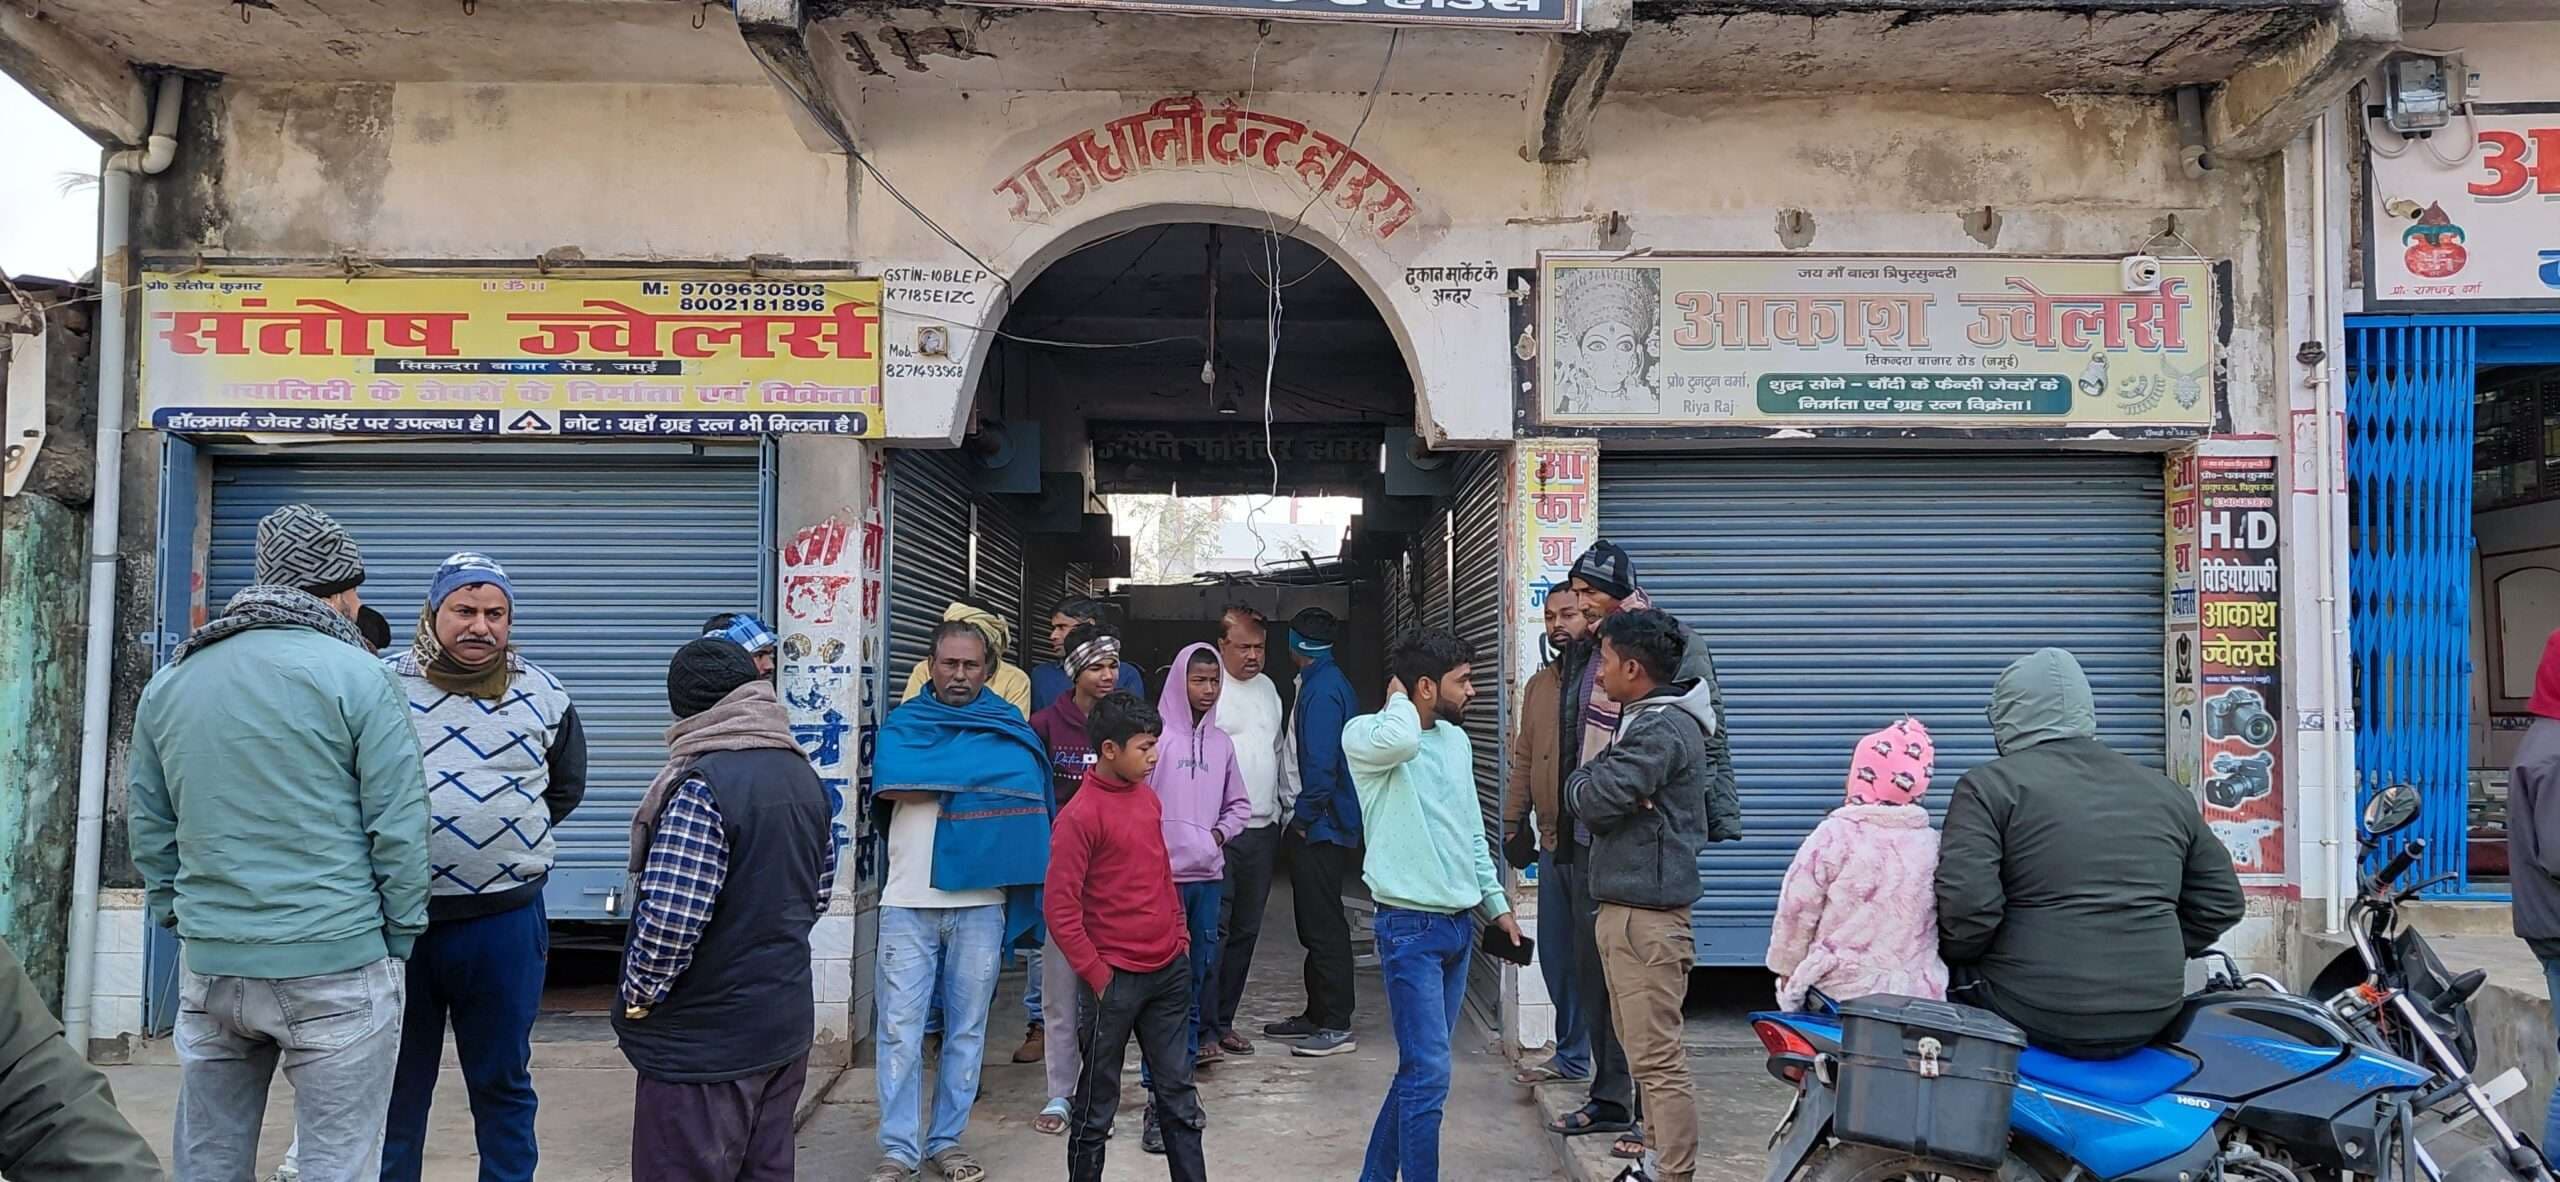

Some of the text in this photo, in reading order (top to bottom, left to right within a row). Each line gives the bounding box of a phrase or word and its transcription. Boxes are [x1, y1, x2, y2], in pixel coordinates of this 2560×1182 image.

[1798, 269, 1822, 279] जय
[1827, 265, 1845, 279] माँ
[219, 282, 262, 294] कुमार
[1405, 268, 1444, 293] दुकान
[642, 282, 826, 298] M: 9709630503
[679, 298, 825, 313] 8002181896
[1673, 276, 2189, 351] आकाश ज्वेलर्स
[150, 298, 880, 359] संतोष ज्वेलर्स
[397, 359, 480, 371] सिकन्दरा
[491, 361, 548, 371] बाजार
[613, 362, 657, 375] जमुई
[1865, 353, 1912, 366] सिकन्दरा
[1917, 356, 1952, 365] बाजार
[1957, 354, 1976, 366] रोड
[367, 380, 406, 401] के
[416, 380, 508, 402] जेवरों
[513, 381, 556, 402] के
[567, 380, 683, 403] निर्माता
[696, 381, 750, 404] एवं
[1808, 377, 1846, 390] सोने
[1867, 377, 1906, 390] चाँदी
[1911, 377, 1930, 390] के
[1988, 378, 2037, 391] जेवरों
[2040, 378, 2060, 391] के
[1683, 400, 1735, 416] Riya Raj
[1798, 396, 1860, 410] निर्माता
[1863, 397, 1892, 410] एवं
[167, 412, 250, 430] हॉलमार्क
[256, 414, 305, 429] जेवर
[306, 414, 360, 431] ऑर्डर
[363, 418, 390, 430] पर
[564, 414, 600, 432] नोट
[619, 414, 657, 431] यहाँ
[659, 419, 692, 434] ग्रह
[739, 414, 765, 433] भी
[768, 414, 830, 433] मिलता
[2202, 511, 2277, 549] H.D
[2202, 602, 2277, 628] आकाश
[2201, 632, 2277, 667] ज्वेलर्स
[2177, 1095, 2210, 1109] Hero
